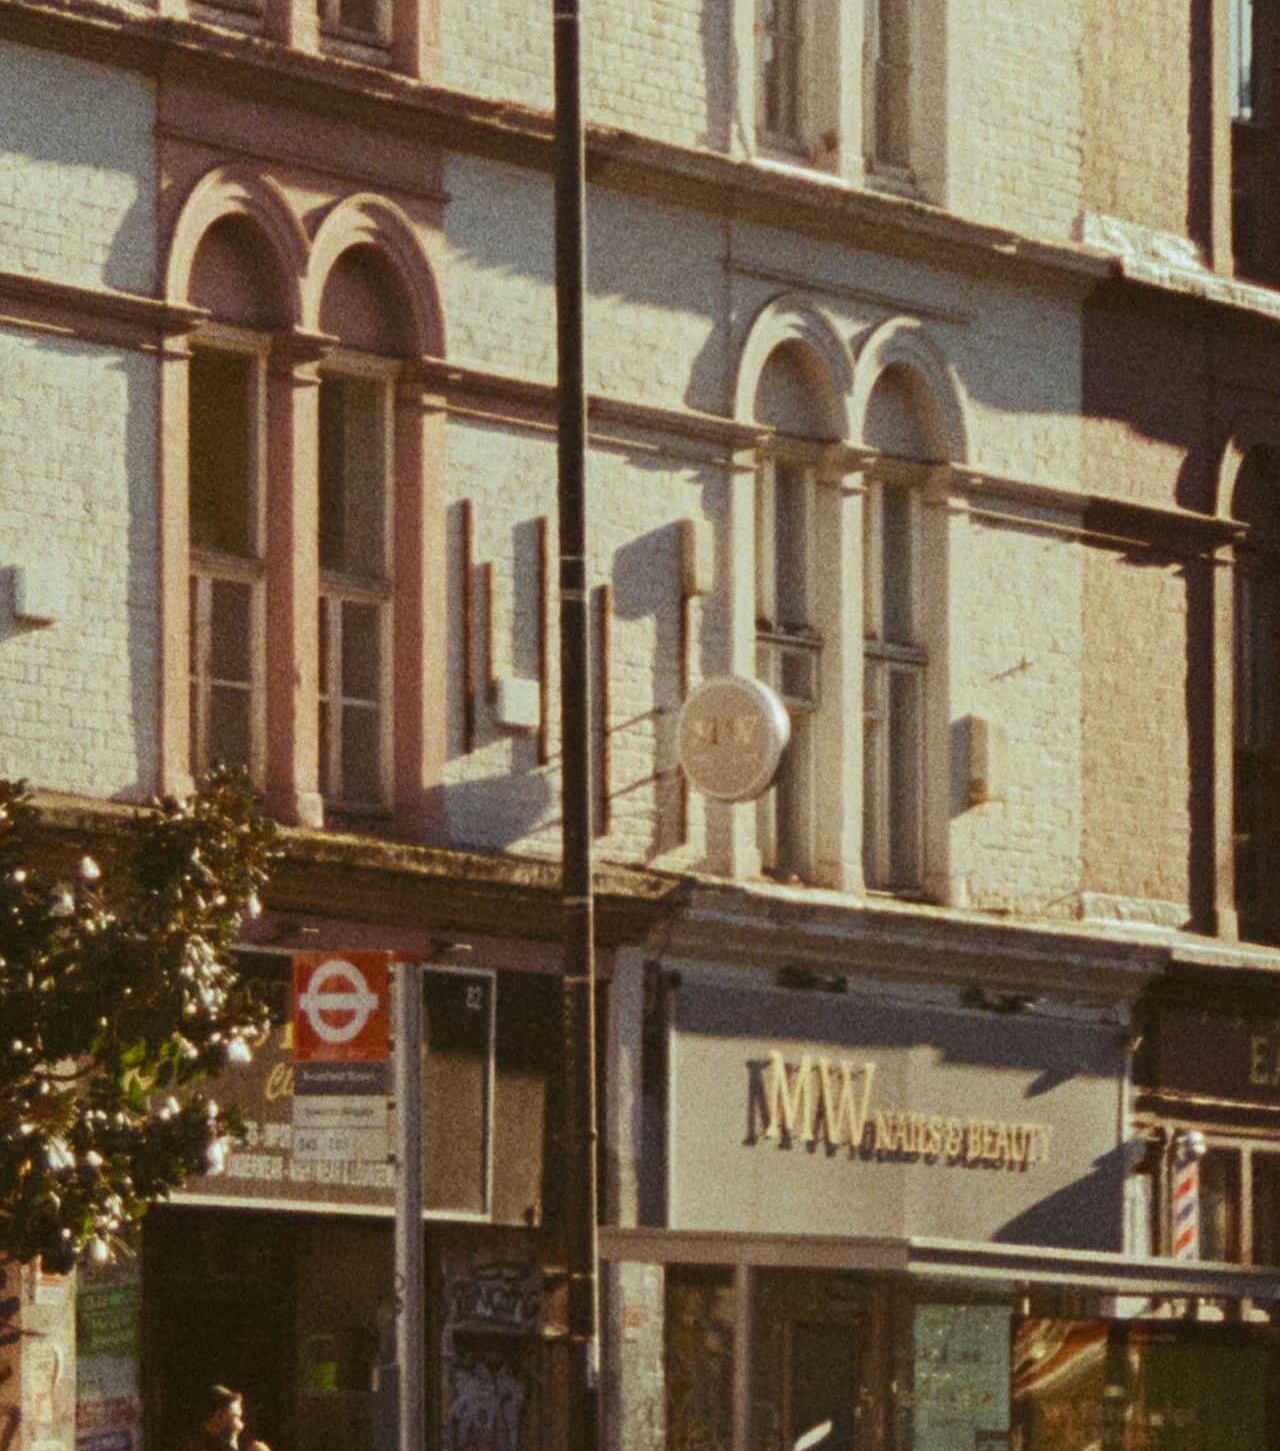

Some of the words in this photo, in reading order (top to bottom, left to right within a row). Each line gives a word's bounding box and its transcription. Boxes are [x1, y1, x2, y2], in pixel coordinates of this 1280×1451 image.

[764, 1049, 875, 1148] MW
[874, 1109, 941, 1155] NAILS
[966, 1119, 1052, 1165] BEAUTY
